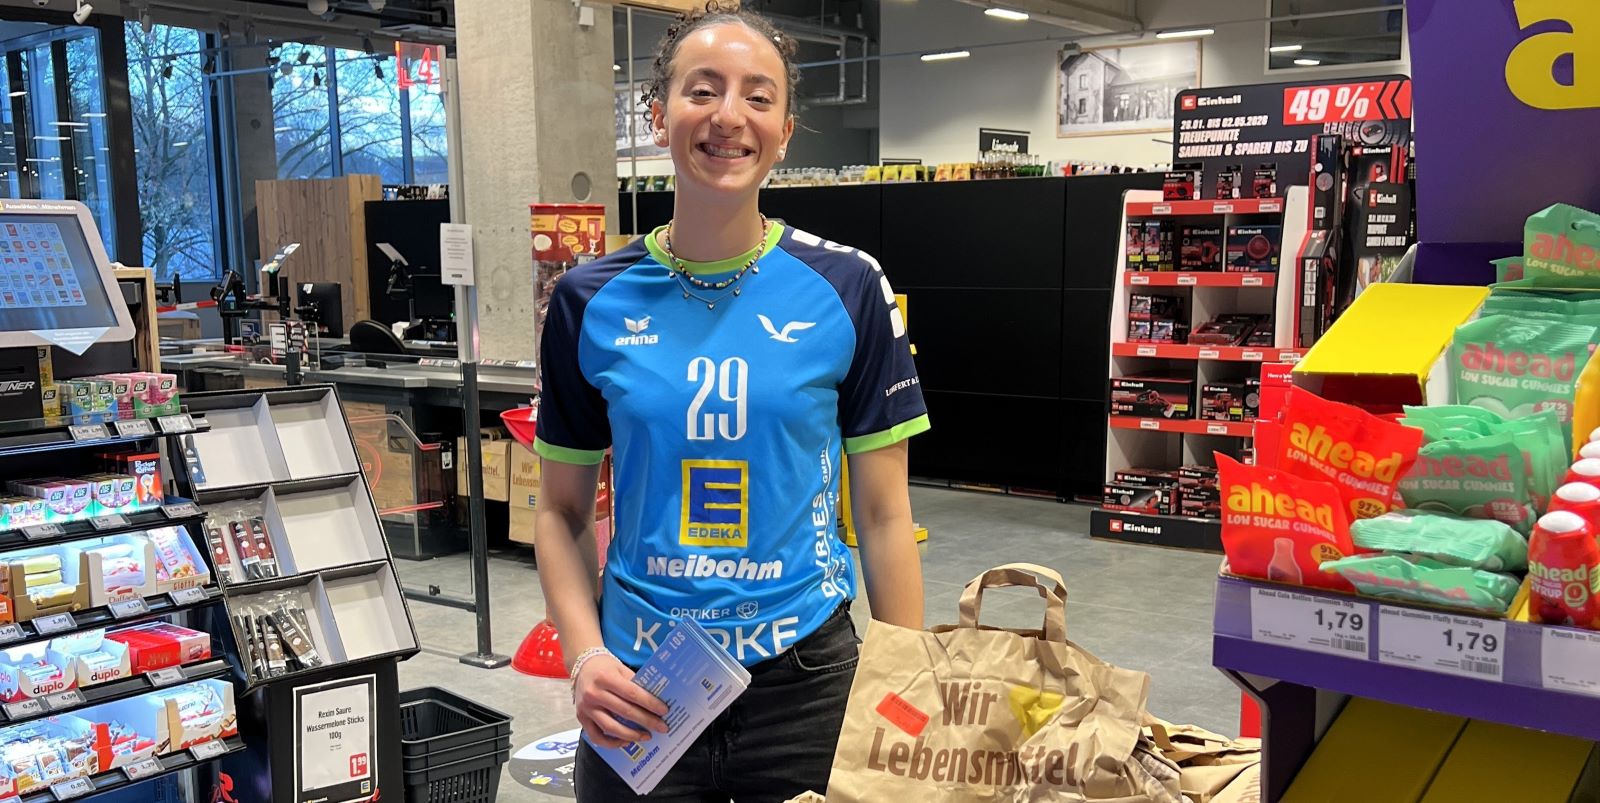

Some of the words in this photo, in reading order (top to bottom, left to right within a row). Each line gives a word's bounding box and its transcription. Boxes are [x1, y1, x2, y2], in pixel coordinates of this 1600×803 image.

[1198, 95, 1241, 106] Einhell
[1289, 88, 1330, 121] 49
[1207, 118, 1221, 128] BIS
[1179, 129, 1240, 143] TREUEPUNKTE
[1178, 144, 1223, 158] SAMMELN
[1224, 143, 1233, 155] &
[1234, 141, 1272, 155] SPAREN
[1273, 140, 1293, 153] BIS
[1294, 140, 1308, 152] ZU
[614, 333, 658, 346] erima
[1460, 341, 1575, 382] ahead
[1481, 374, 1518, 388] SUGAR
[1521, 379, 1570, 394] GUMMIES
[687, 357, 749, 440] 29
[1290, 422, 1403, 482] ahead
[1286, 448, 1307, 463] LOW
[1308, 457, 1337, 482] SUGAR
[1338, 473, 1391, 497] GUMMIES
[1422, 480, 1460, 490] SUGAR
[1463, 481, 1515, 493] GUMMIES
[1227, 483, 1334, 532] ahead
[688, 527, 742, 539] EDEKA
[1124, 523, 1161, 535] Einhell
[1227, 514, 1250, 526] LOW
[1253, 515, 1290, 531] SUGAR
[1293, 524, 1337, 543] GUMMIES
[646, 554, 782, 580] Meibohm
[1529, 560, 1587, 582] ahead
[670, 607, 730, 619] OPTIKER
[1314, 608, 1363, 631] 1,79
[1442, 629, 1497, 653] 1,79
[91, 668, 121, 682] duplo
[33, 681, 64, 695] duplo
[939, 681, 998, 727] Wir
[307, 719, 346, 732] Wassermelone
[347, 715, 365, 725] Sticks
[630, 745, 660, 778] Meibohm
